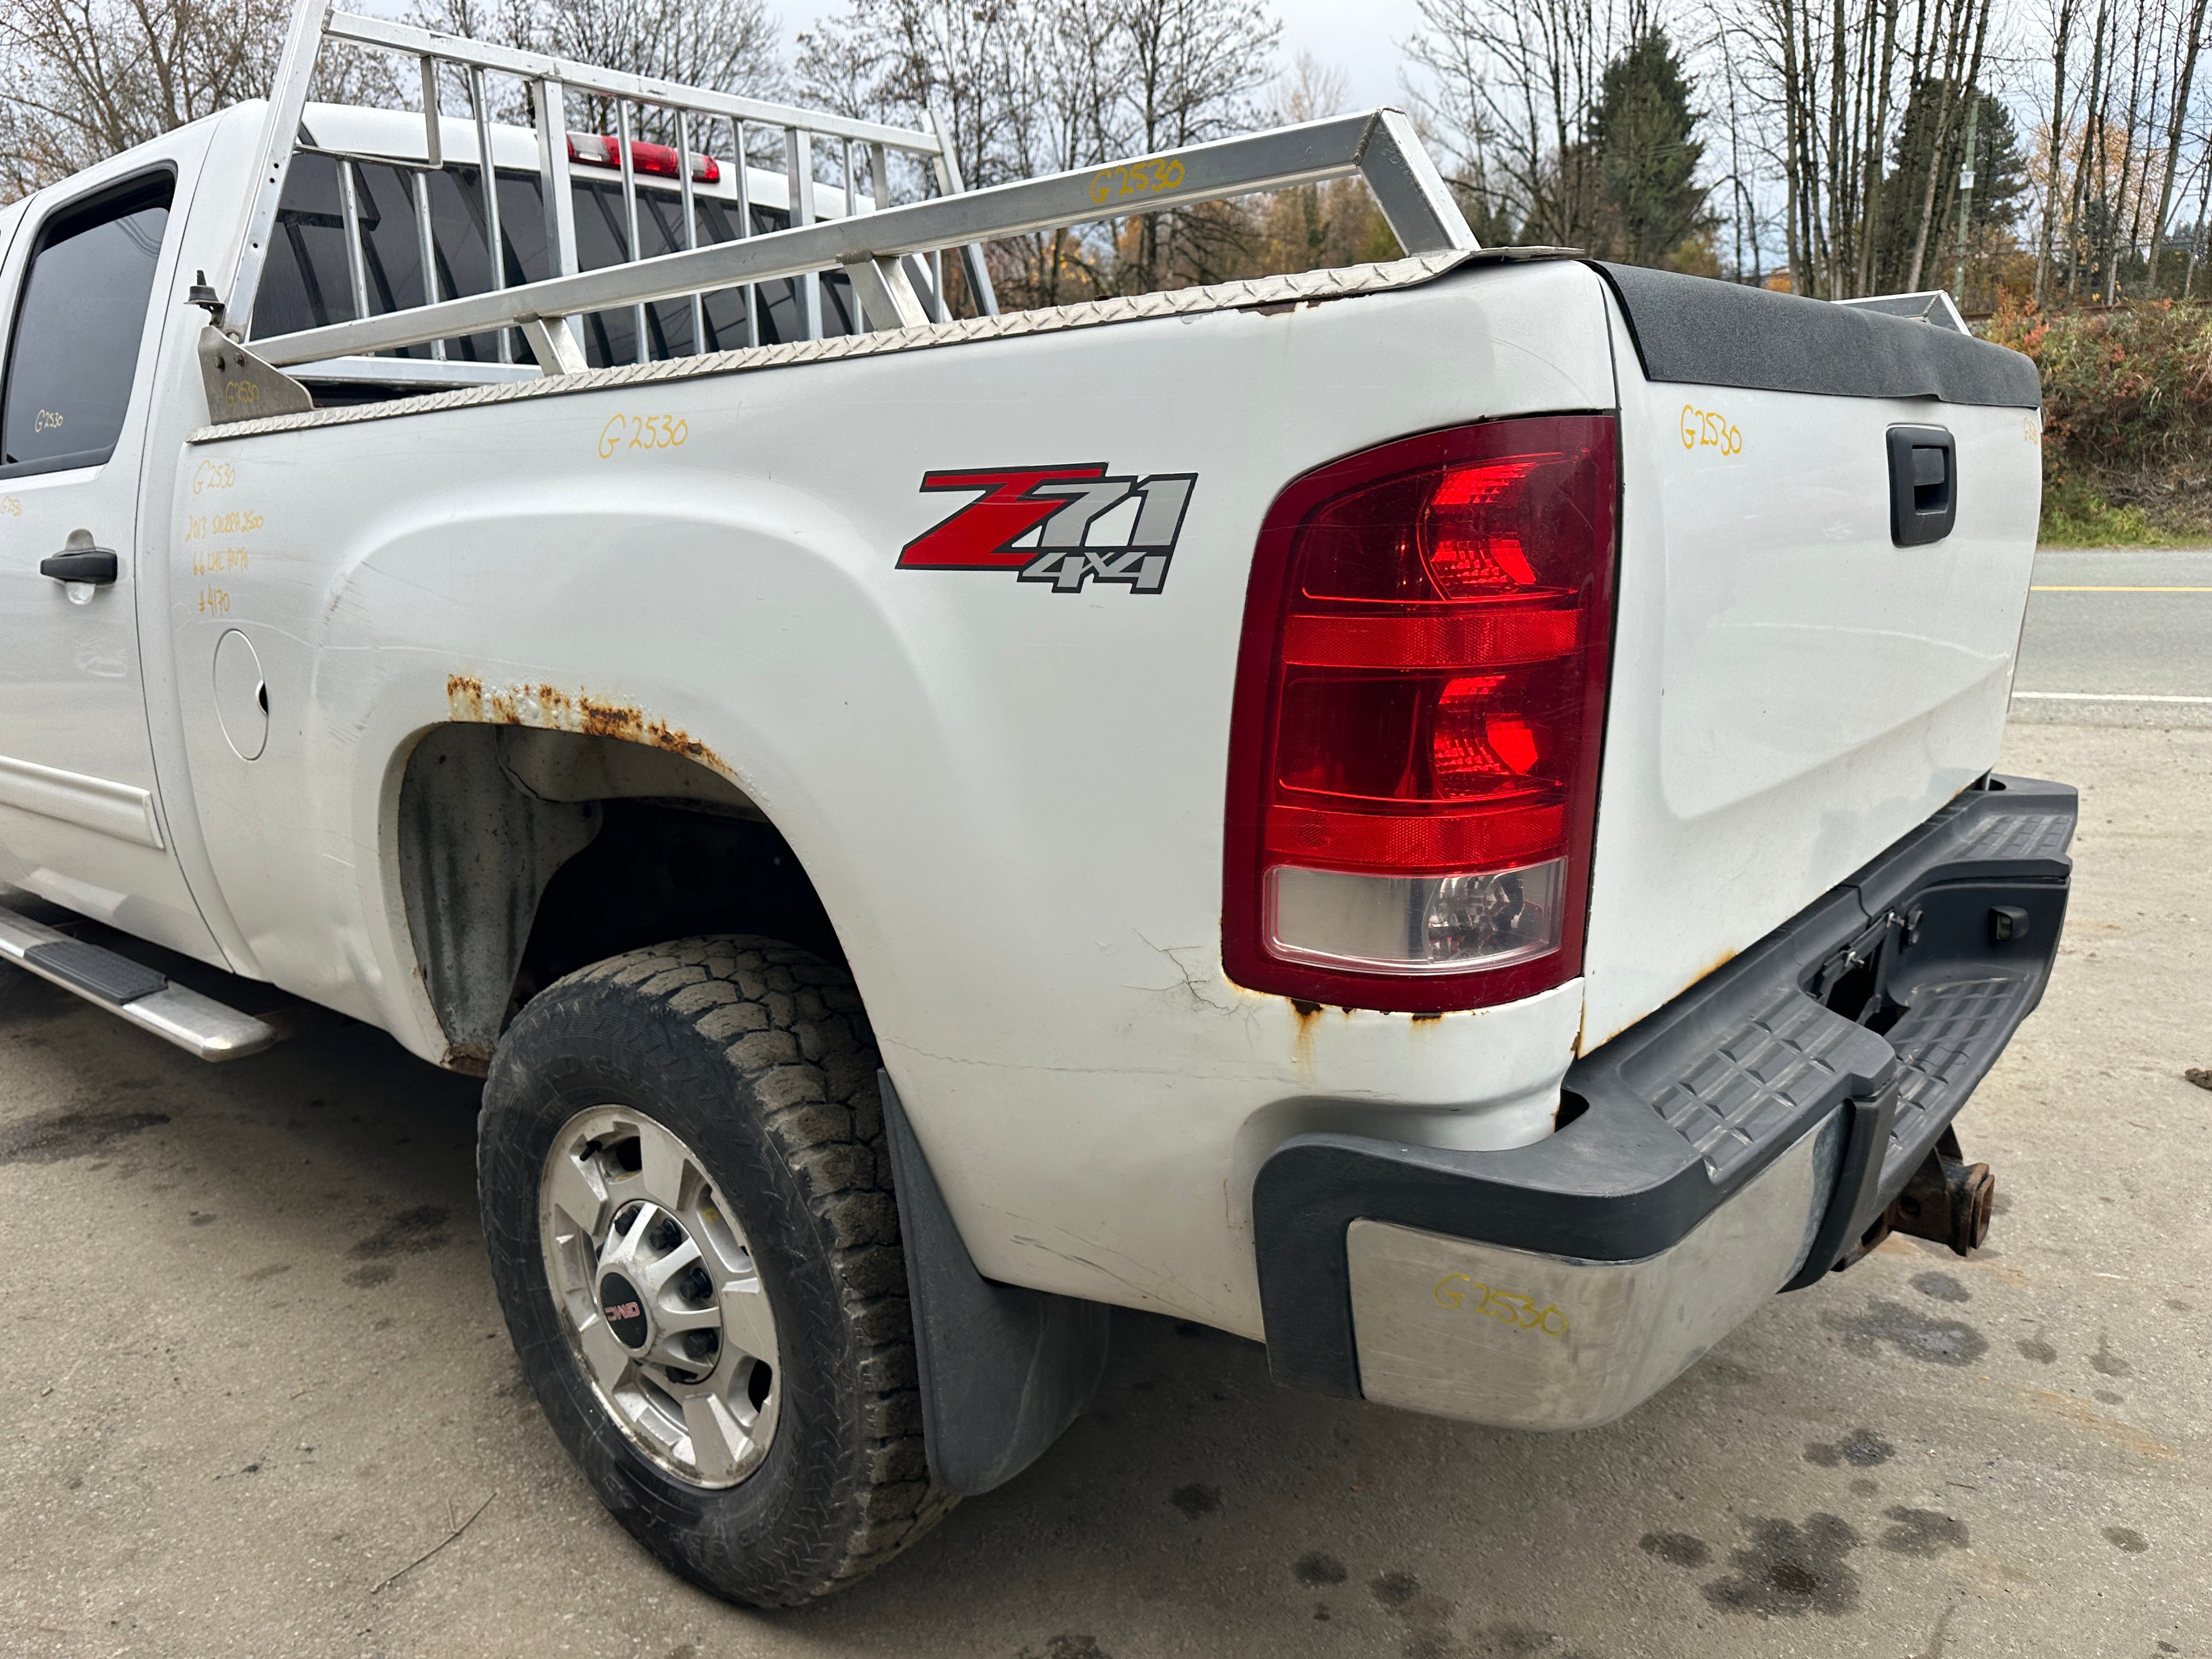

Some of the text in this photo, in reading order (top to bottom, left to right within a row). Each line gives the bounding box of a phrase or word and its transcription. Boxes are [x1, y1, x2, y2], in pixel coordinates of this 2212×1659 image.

[1089, 158, 1185, 203] G2530
[35, 409, 64, 433] G2530
[599, 413, 689, 460] G2530
[1680, 404, 1743, 456] G2530
[192, 460, 236, 495] G2530
[895, 461, 1198, 570] Z71
[605, 1302, 641, 1322] GMC
[1434, 1272, 1569, 1336] G2530
